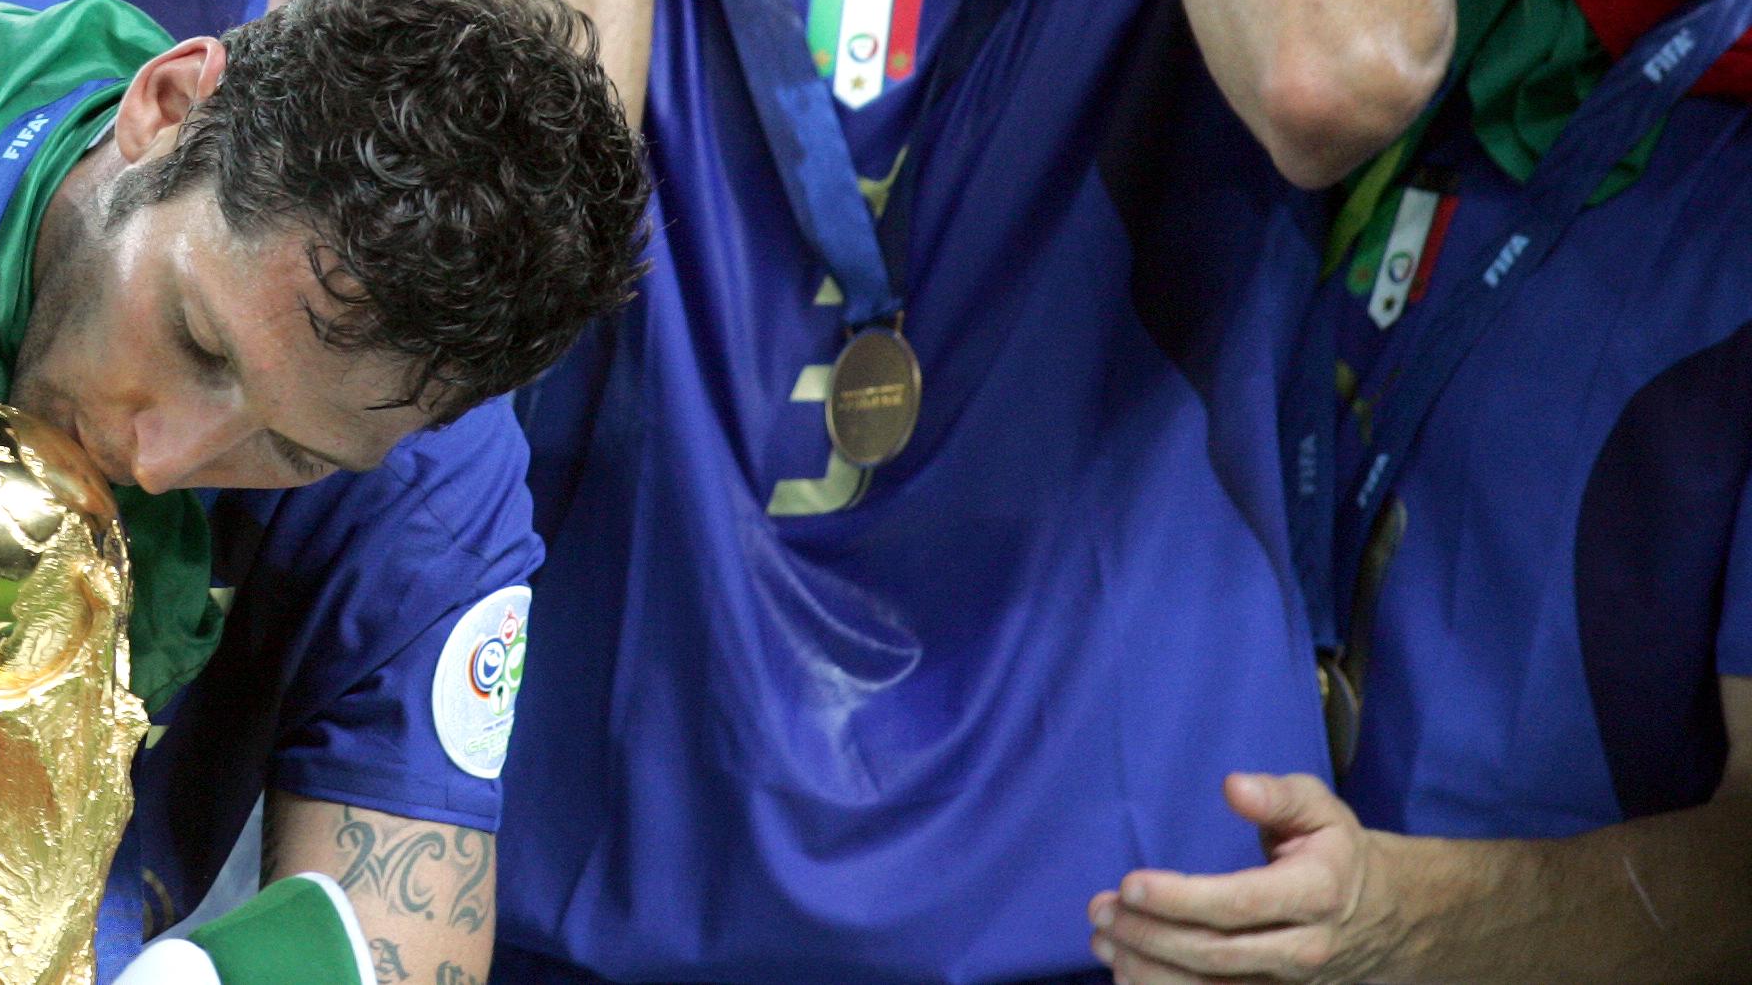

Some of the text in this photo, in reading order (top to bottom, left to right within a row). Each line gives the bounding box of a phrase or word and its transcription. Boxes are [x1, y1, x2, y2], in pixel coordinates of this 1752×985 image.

[1643, 34, 1695, 83] FIFA
[2, 117, 50, 160] FIFA
[1483, 234, 1530, 288] FIFA
